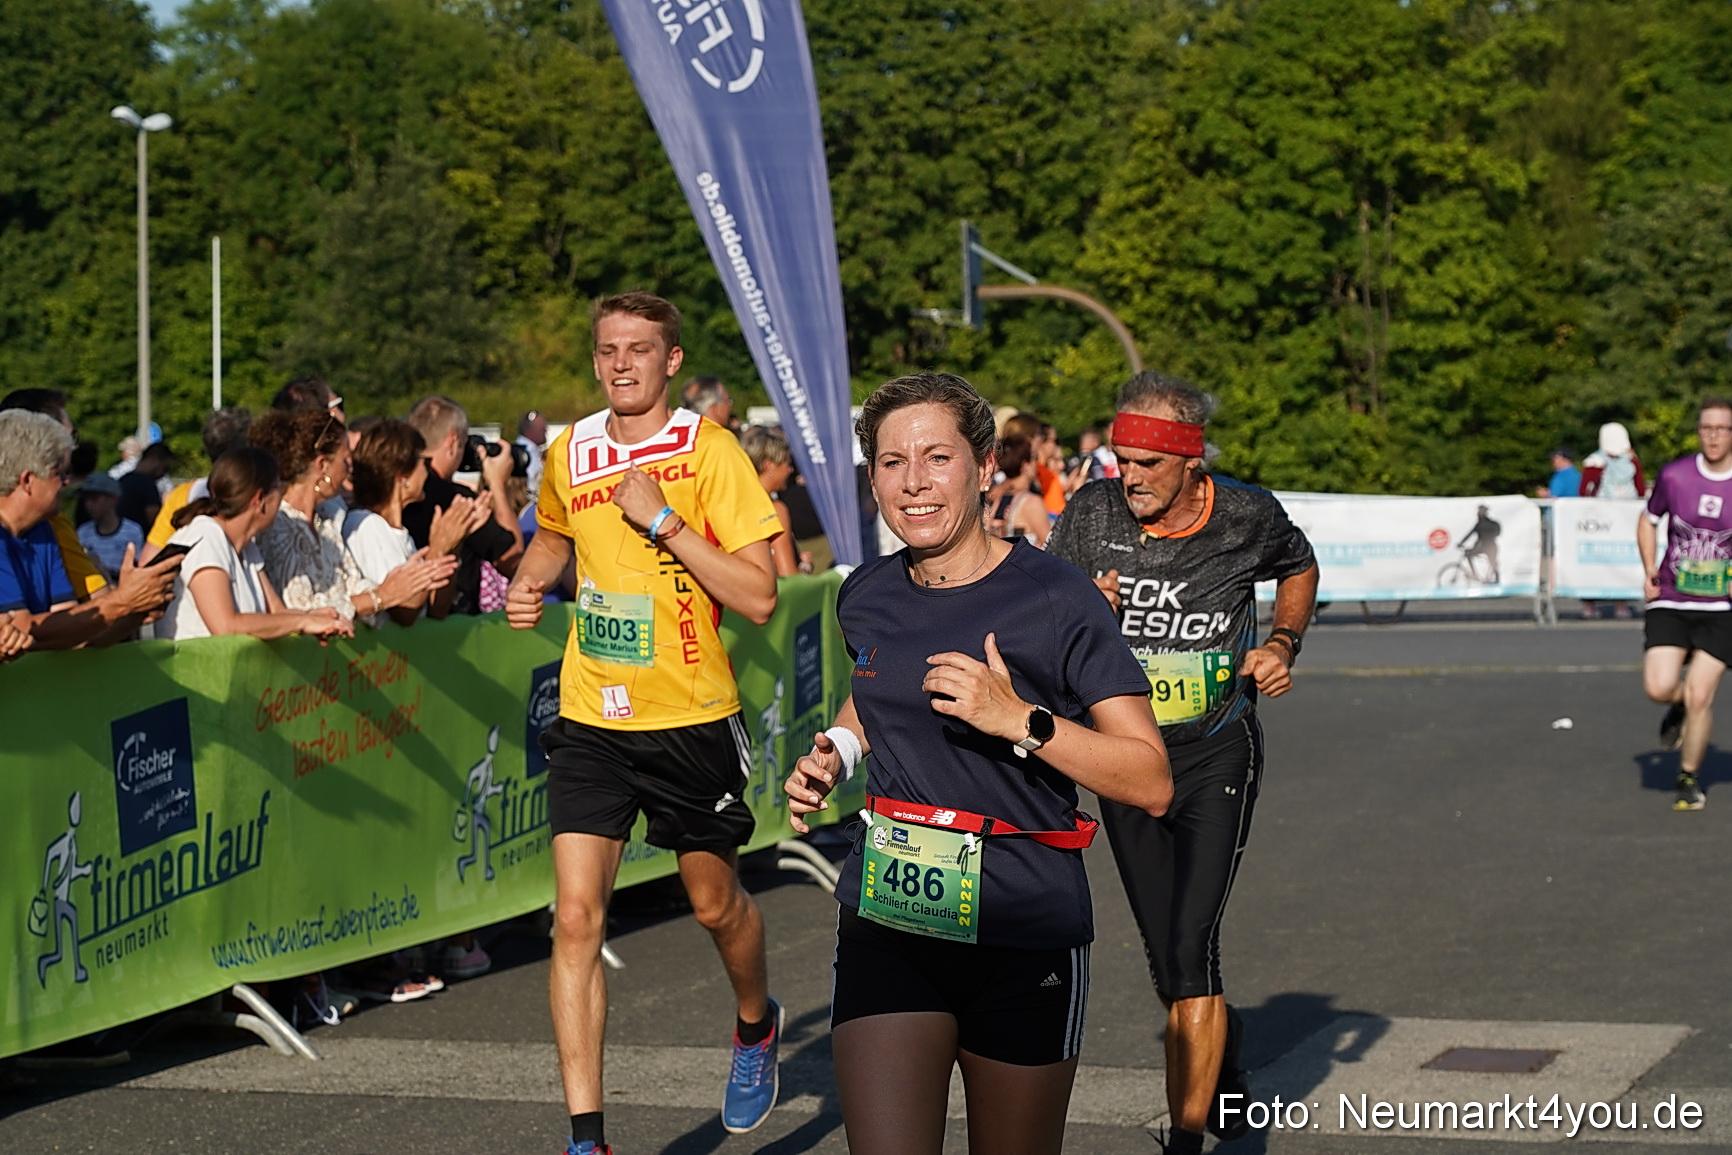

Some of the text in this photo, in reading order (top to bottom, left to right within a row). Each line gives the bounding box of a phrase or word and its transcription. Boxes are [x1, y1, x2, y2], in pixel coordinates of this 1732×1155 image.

[647, 462, 696, 482] ÖGL
[1097, 570, 1188, 609] ECK
[585, 612, 637, 642] 1603
[639, 623, 649, 657] 2022
[1121, 610, 1231, 640] ESIGN
[610, 642, 638, 652] Marius
[256, 651, 409, 732] Gesunde Firmen
[1191, 682, 1202, 711] 2022
[292, 684, 422, 779] laufen länger!
[128, 747, 177, 782] Fischer
[502, 776, 550, 842] firm
[902, 811, 926, 821] balance
[91, 790, 271, 934] firmenlauf
[866, 861, 876, 898] RUN
[883, 858, 945, 902] 486
[873, 889, 958, 920] Schlierf Claudia
[959, 878, 973, 927] 2022
[96, 912, 169, 968] neumarkt
[212, 884, 420, 968] www.firmenlauf-oberpfalz.de
